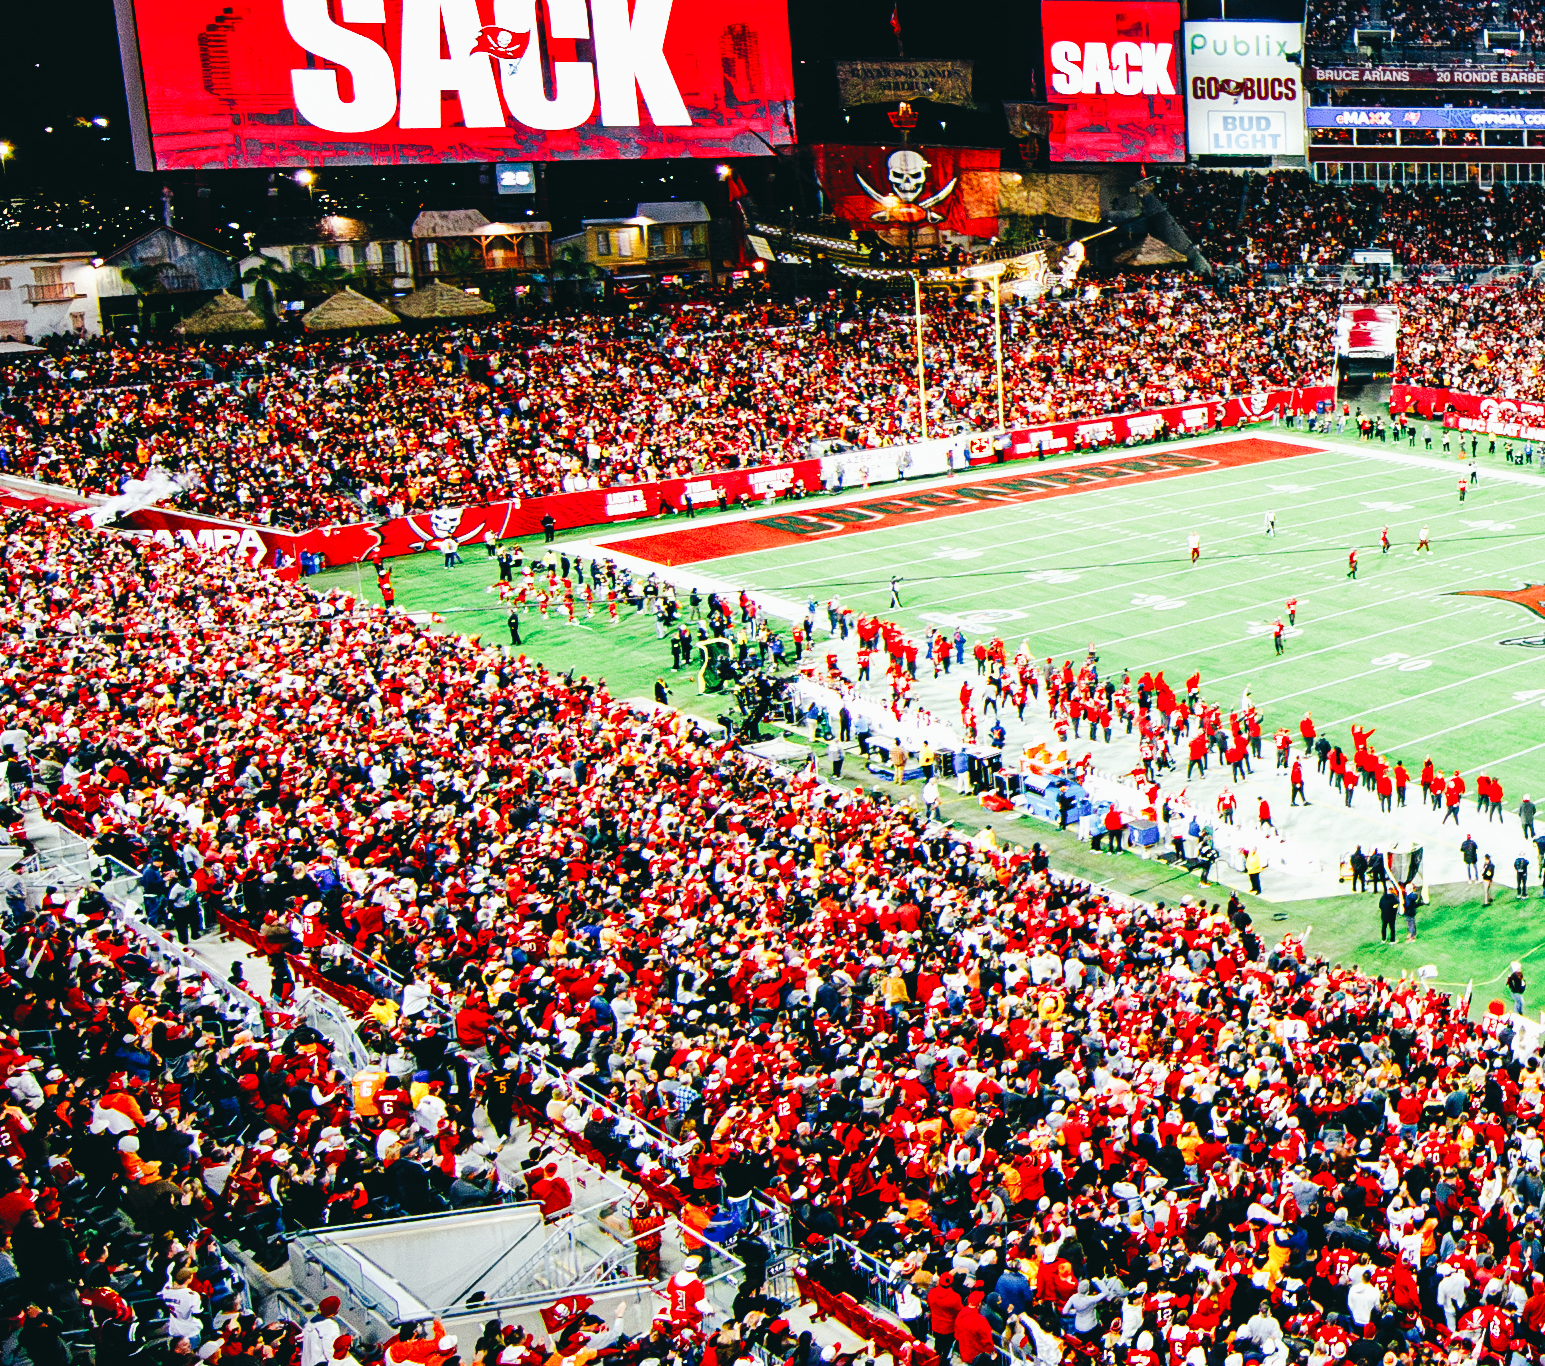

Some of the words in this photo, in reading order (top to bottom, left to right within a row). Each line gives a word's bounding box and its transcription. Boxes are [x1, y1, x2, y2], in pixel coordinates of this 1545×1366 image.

[1191, 33, 1287, 56] Publix
[1051, 41, 1175, 96] SACK
[1316, 69, 1358, 82] BRUCE
[1361, 70, 1410, 83] ARIANS
[1436, 71, 1450, 83] 20
[1192, 76, 1220, 100] GO
[1242, 77, 1296, 100] BUCS
[1222, 116, 1271, 131] BUD
[1471, 113, 1522, 125] OFFICIAL
[1213, 133, 1281, 149] LIGHT
[1371, 652, 1433, 672] 50
